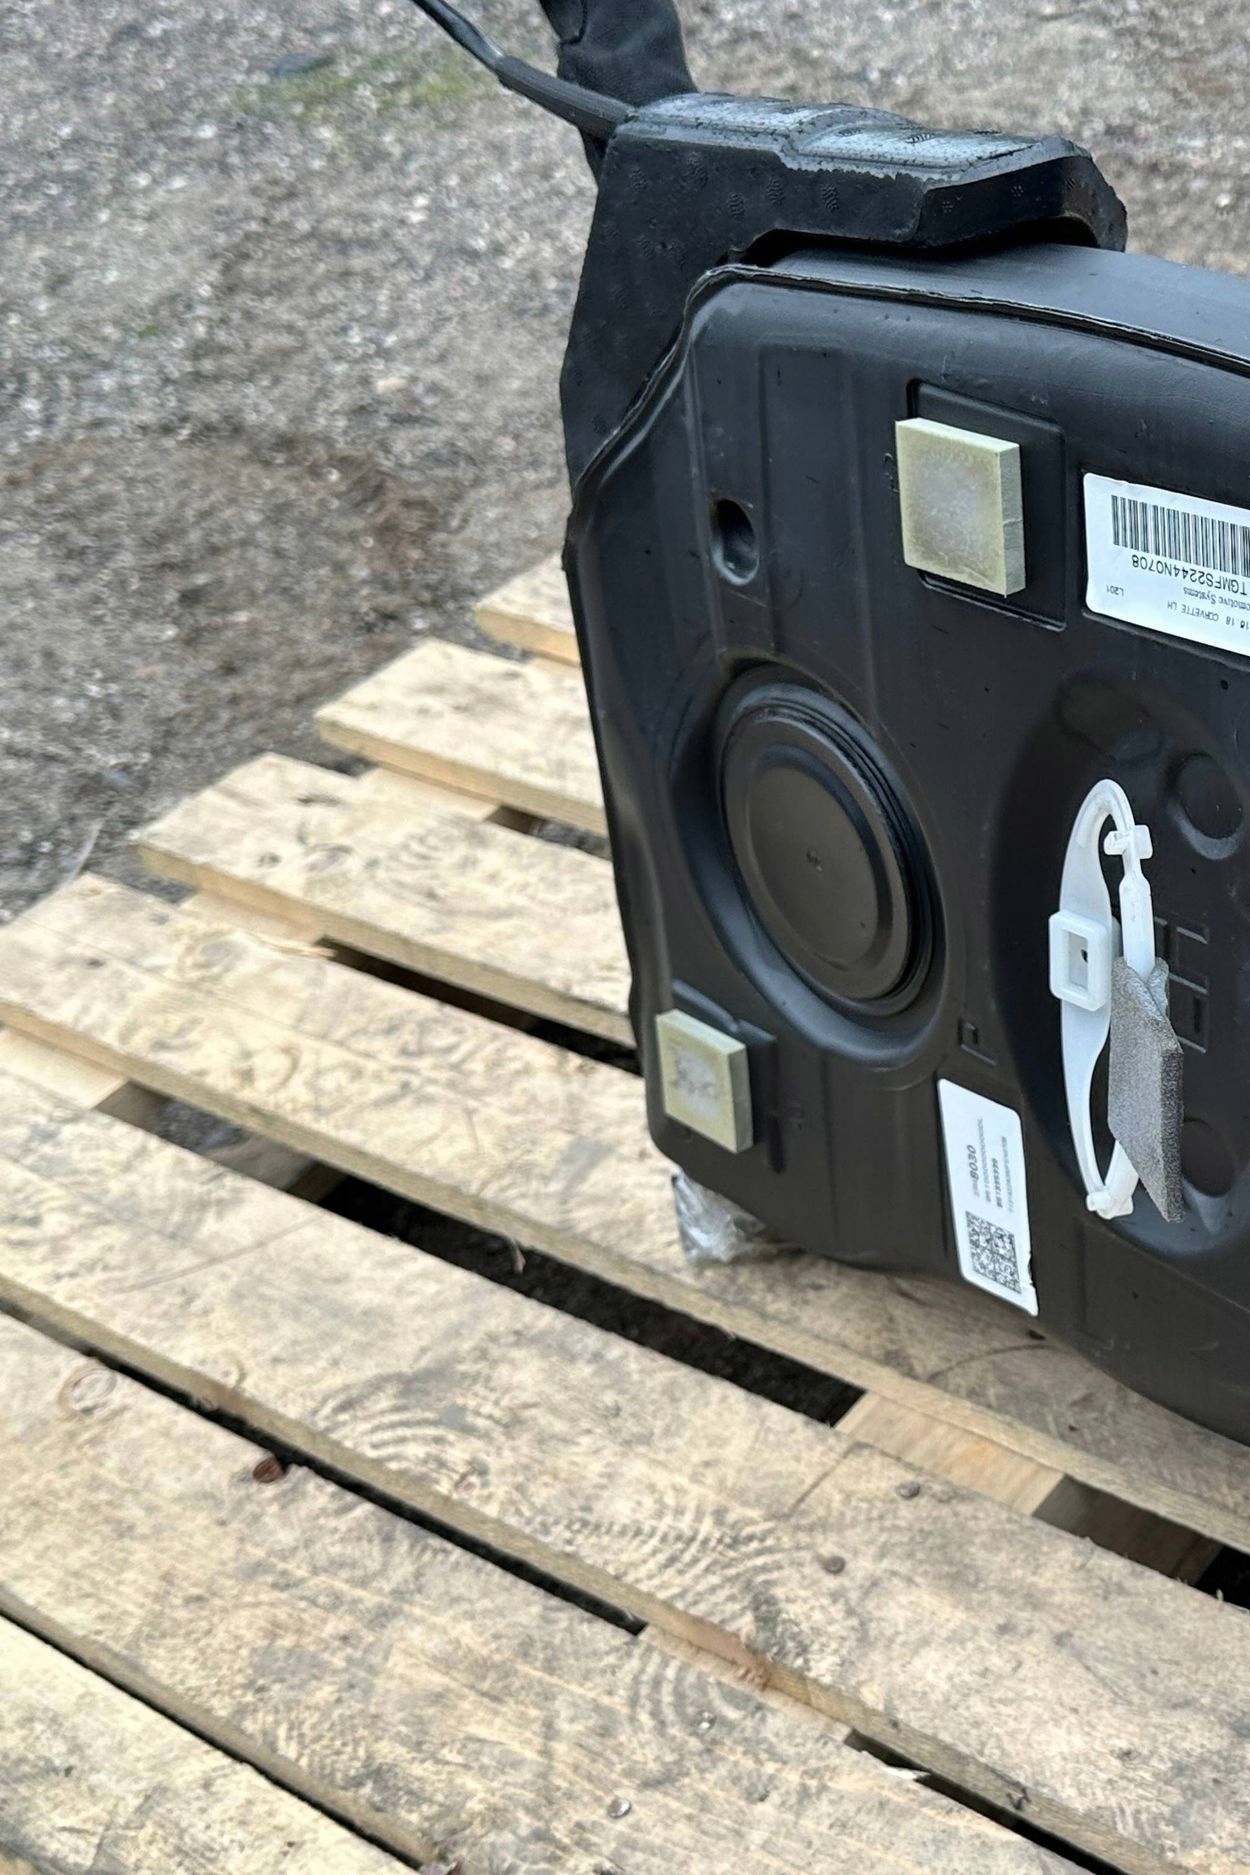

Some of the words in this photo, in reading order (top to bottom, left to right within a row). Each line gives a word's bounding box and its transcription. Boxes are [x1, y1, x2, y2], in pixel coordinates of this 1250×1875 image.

[1130, 554, 1248, 597] TGMFS2244N0708
[1183, 586, 1217, 605] Systems
[1167, 601, 1177, 611] LH
[1180, 603, 1219, 622] CORVETTE
